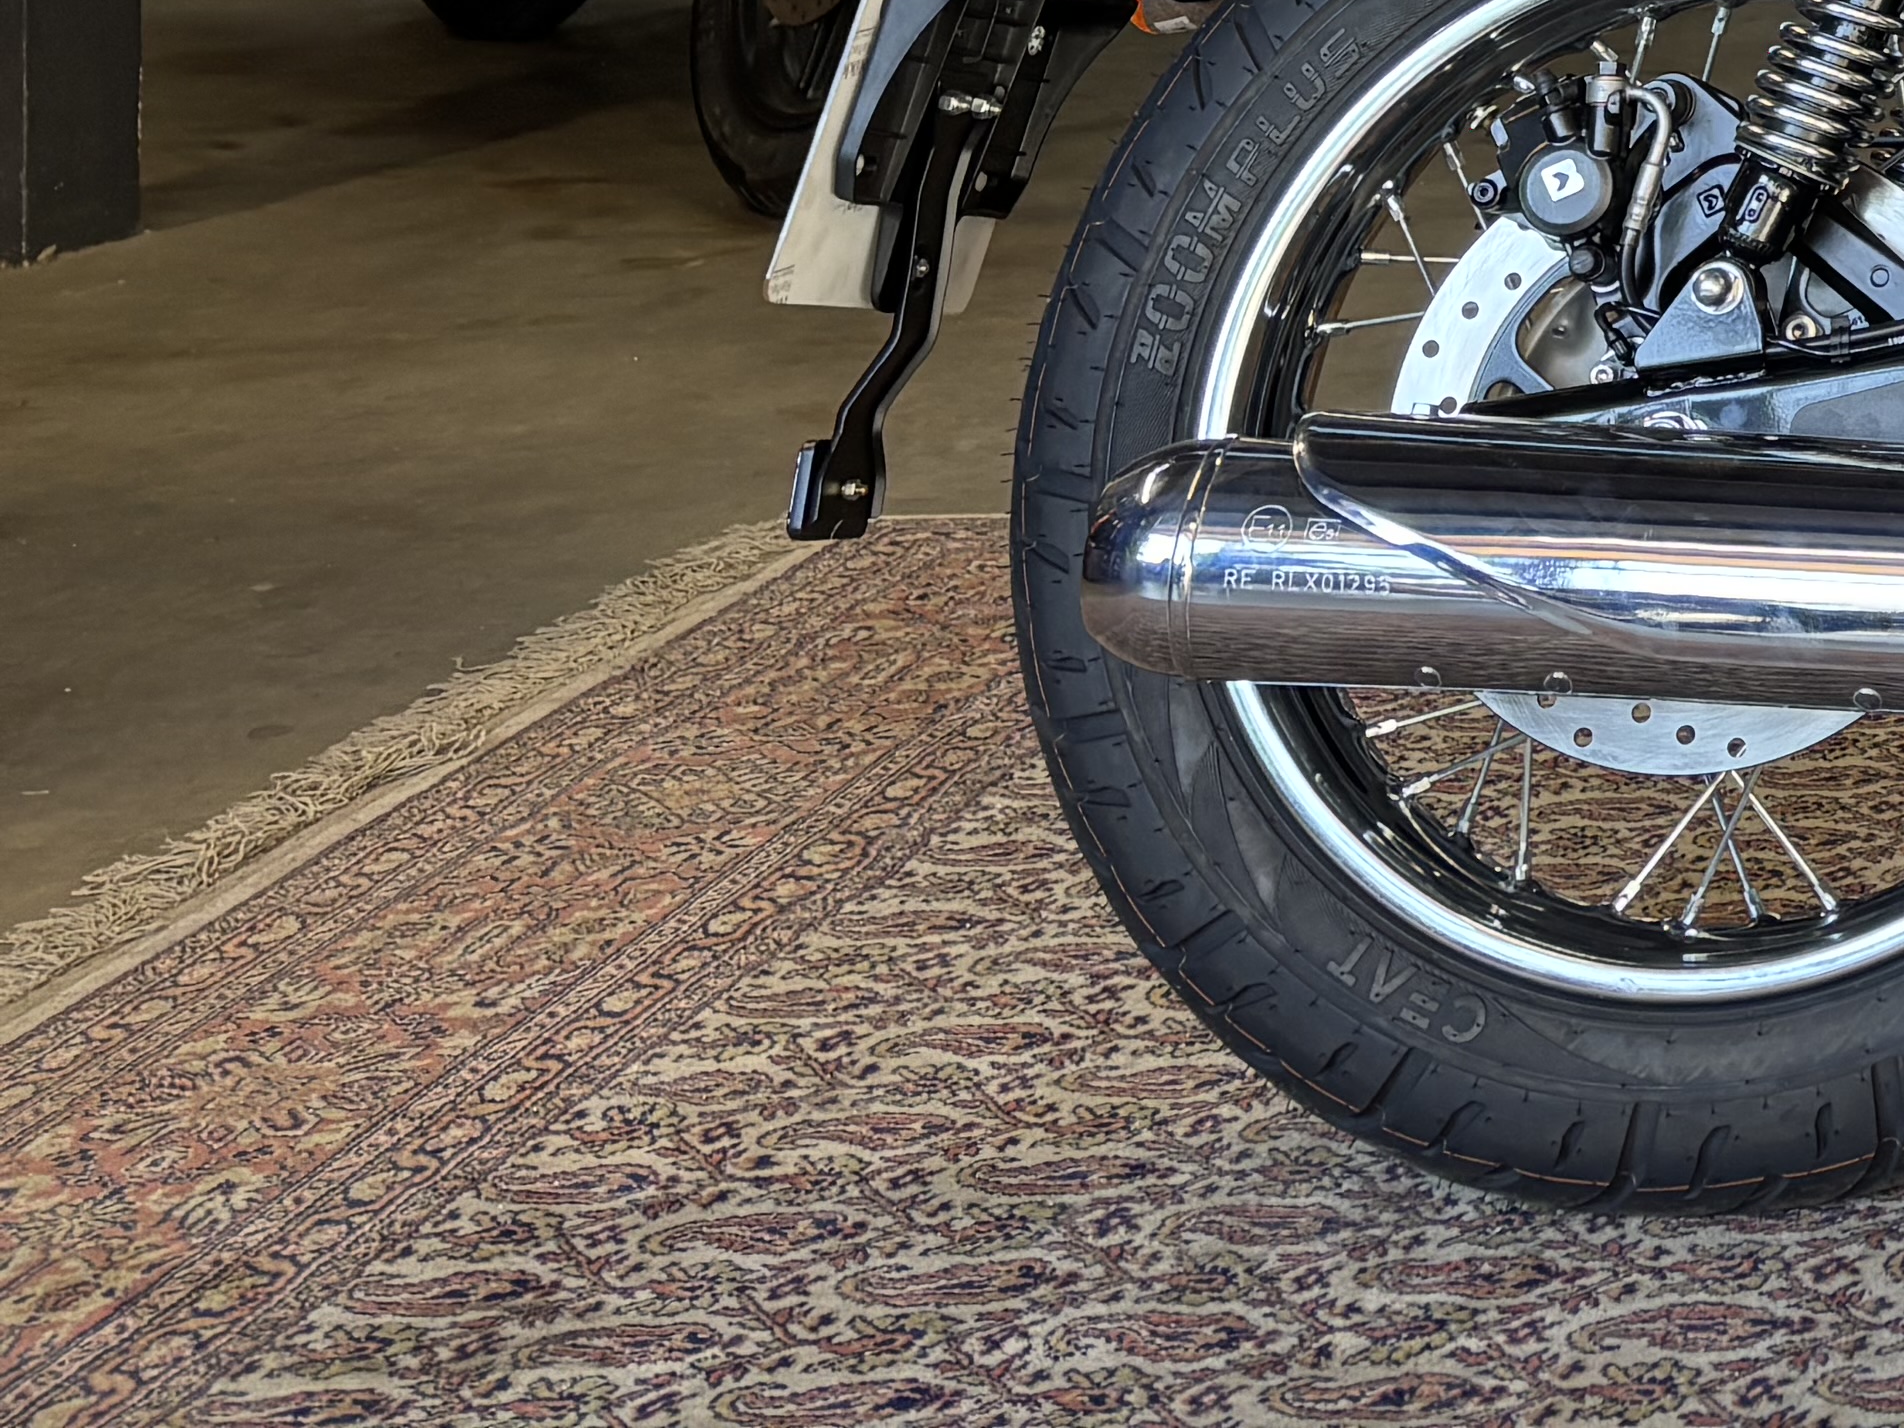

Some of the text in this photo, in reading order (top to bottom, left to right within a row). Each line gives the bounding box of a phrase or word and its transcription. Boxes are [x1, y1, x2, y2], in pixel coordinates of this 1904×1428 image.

[1129, 26, 1365, 378] ZOOM PLUS
[1223, 568, 1257, 590] RE
[1327, 941, 1487, 1044] CEAT
